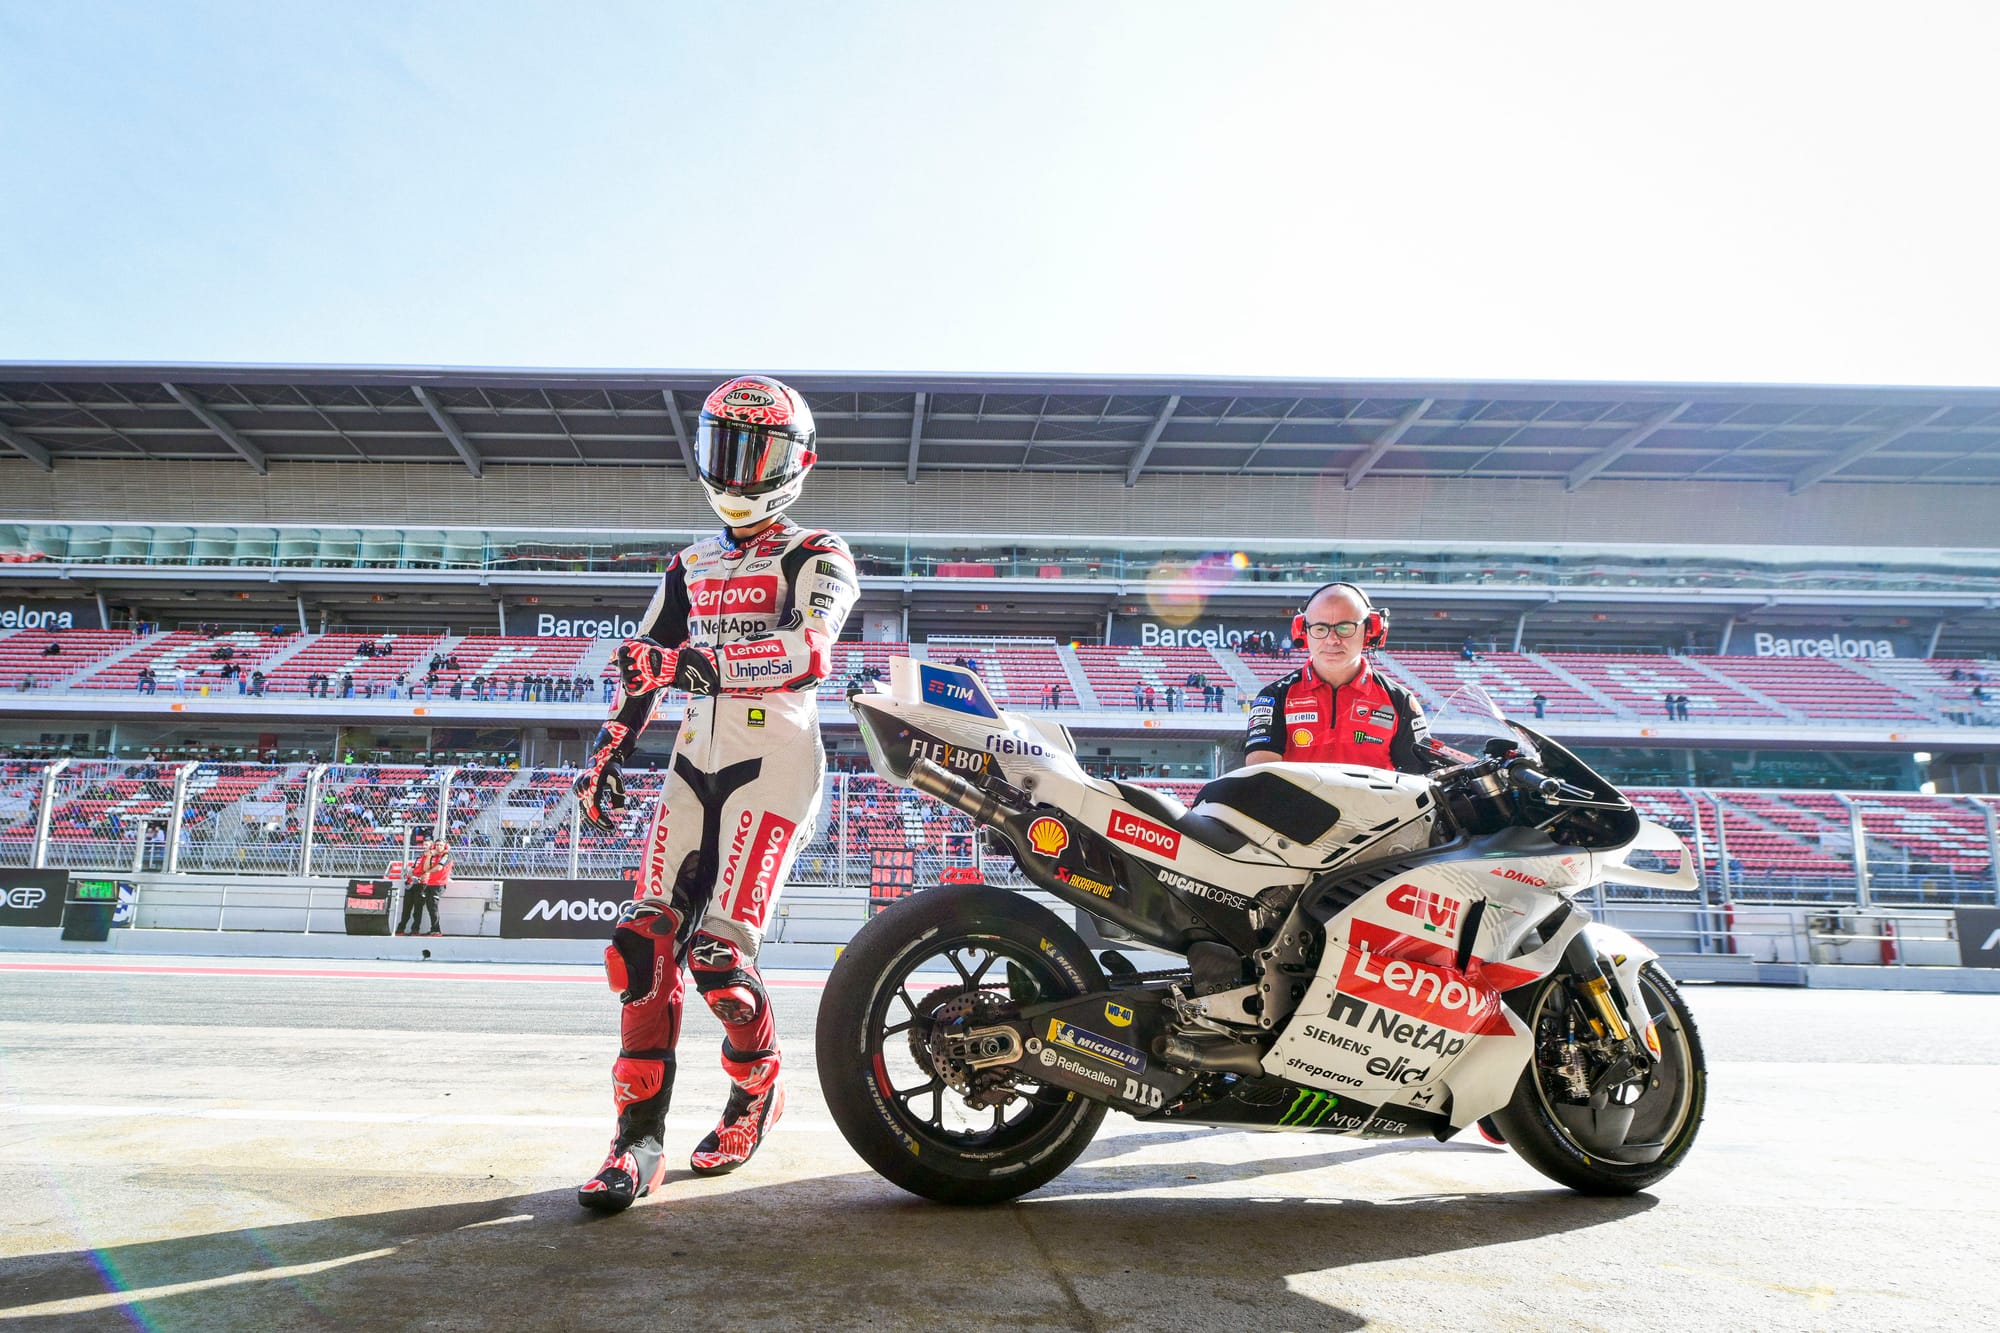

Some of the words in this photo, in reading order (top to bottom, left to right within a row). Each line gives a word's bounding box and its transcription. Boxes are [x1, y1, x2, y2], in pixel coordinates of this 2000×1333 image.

[727, 391, 769, 405] SUOMY
[745, 528, 775, 548] Lenovo
[0, 604, 73, 629] elona
[537, 613, 644, 639] Barcelo
[701, 618, 767, 636] NetApp
[729, 643, 780, 657] Lenovo
[1754, 632, 1895, 658] Barcelona
[729, 659, 793, 681] UnipolSai
[946, 683, 975, 701] TIM
[1294, 713, 1316, 721] riello
[908, 739, 992, 775] FLEX-BOX
[985, 733, 1044, 757] riello
[1114, 815, 1175, 850] Lenovo
[722, 809, 753, 886] DAIKO
[650, 826, 669, 896] DAIKO
[742, 825, 785, 925] Lenovo
[1504, 869, 1547, 888] DAIKO
[1386, 883, 1461, 932] GIVI
[1354, 940, 1490, 1018] Lenov
[1108, 1003, 1131, 1021] WD-40
[1303, 1025, 1372, 1057] SIEMENS
[1367, 1006, 1464, 1060] NetAp
[1077, 1037, 1140, 1066] MICHELIN
[1057, 1056, 1118, 1088] Reflexallen
[1287, 1056, 1364, 1088] streparava
[1328, 1110, 1408, 1135] MOTER
